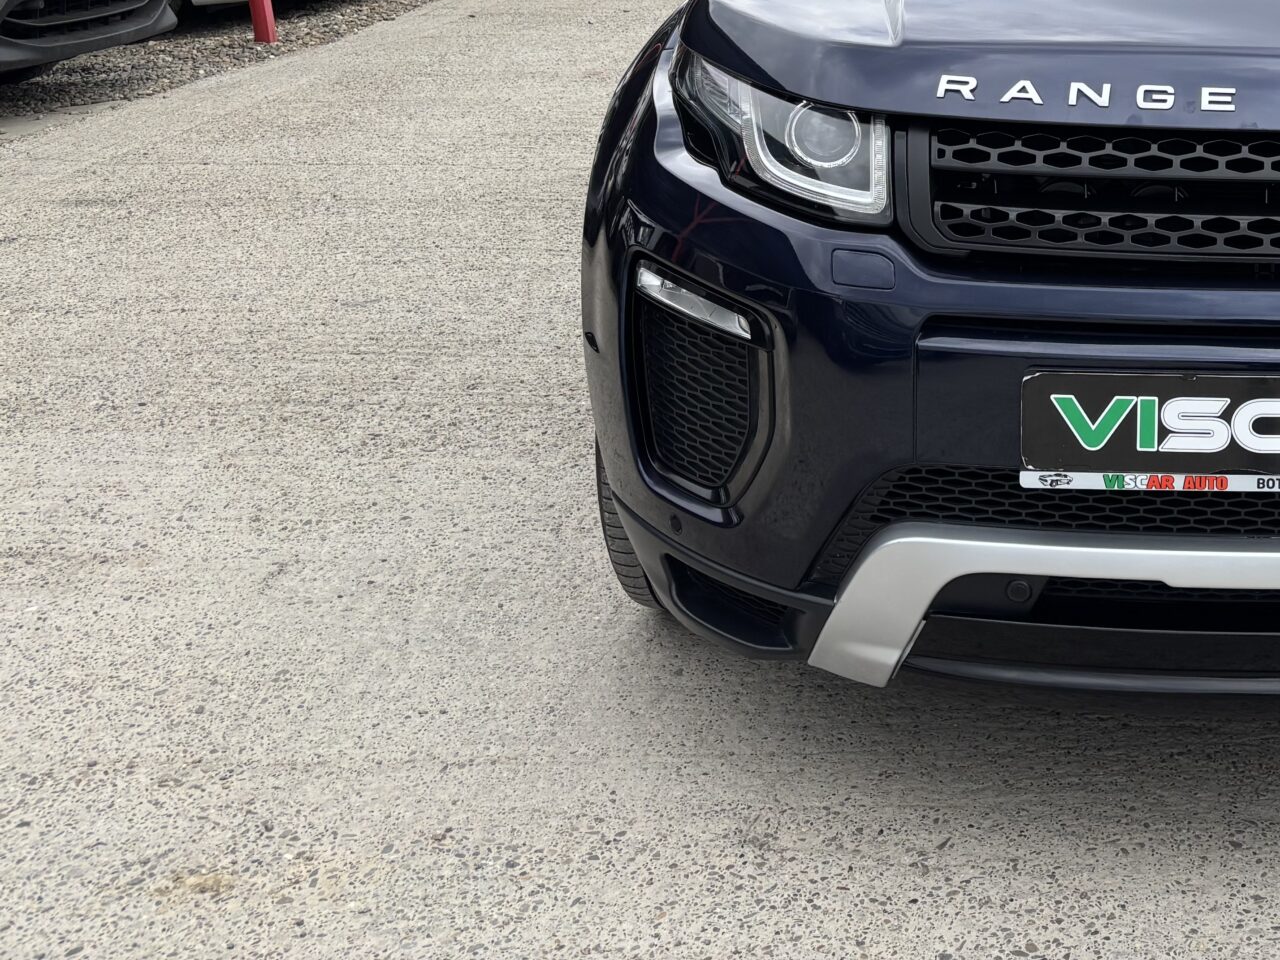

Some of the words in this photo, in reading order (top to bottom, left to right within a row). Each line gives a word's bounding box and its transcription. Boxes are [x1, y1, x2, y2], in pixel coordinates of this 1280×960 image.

[936, 74, 1237, 112] RANGE
[1103, 474, 1175, 490] VISCAR
[1183, 476, 1229, 491] AUTO
